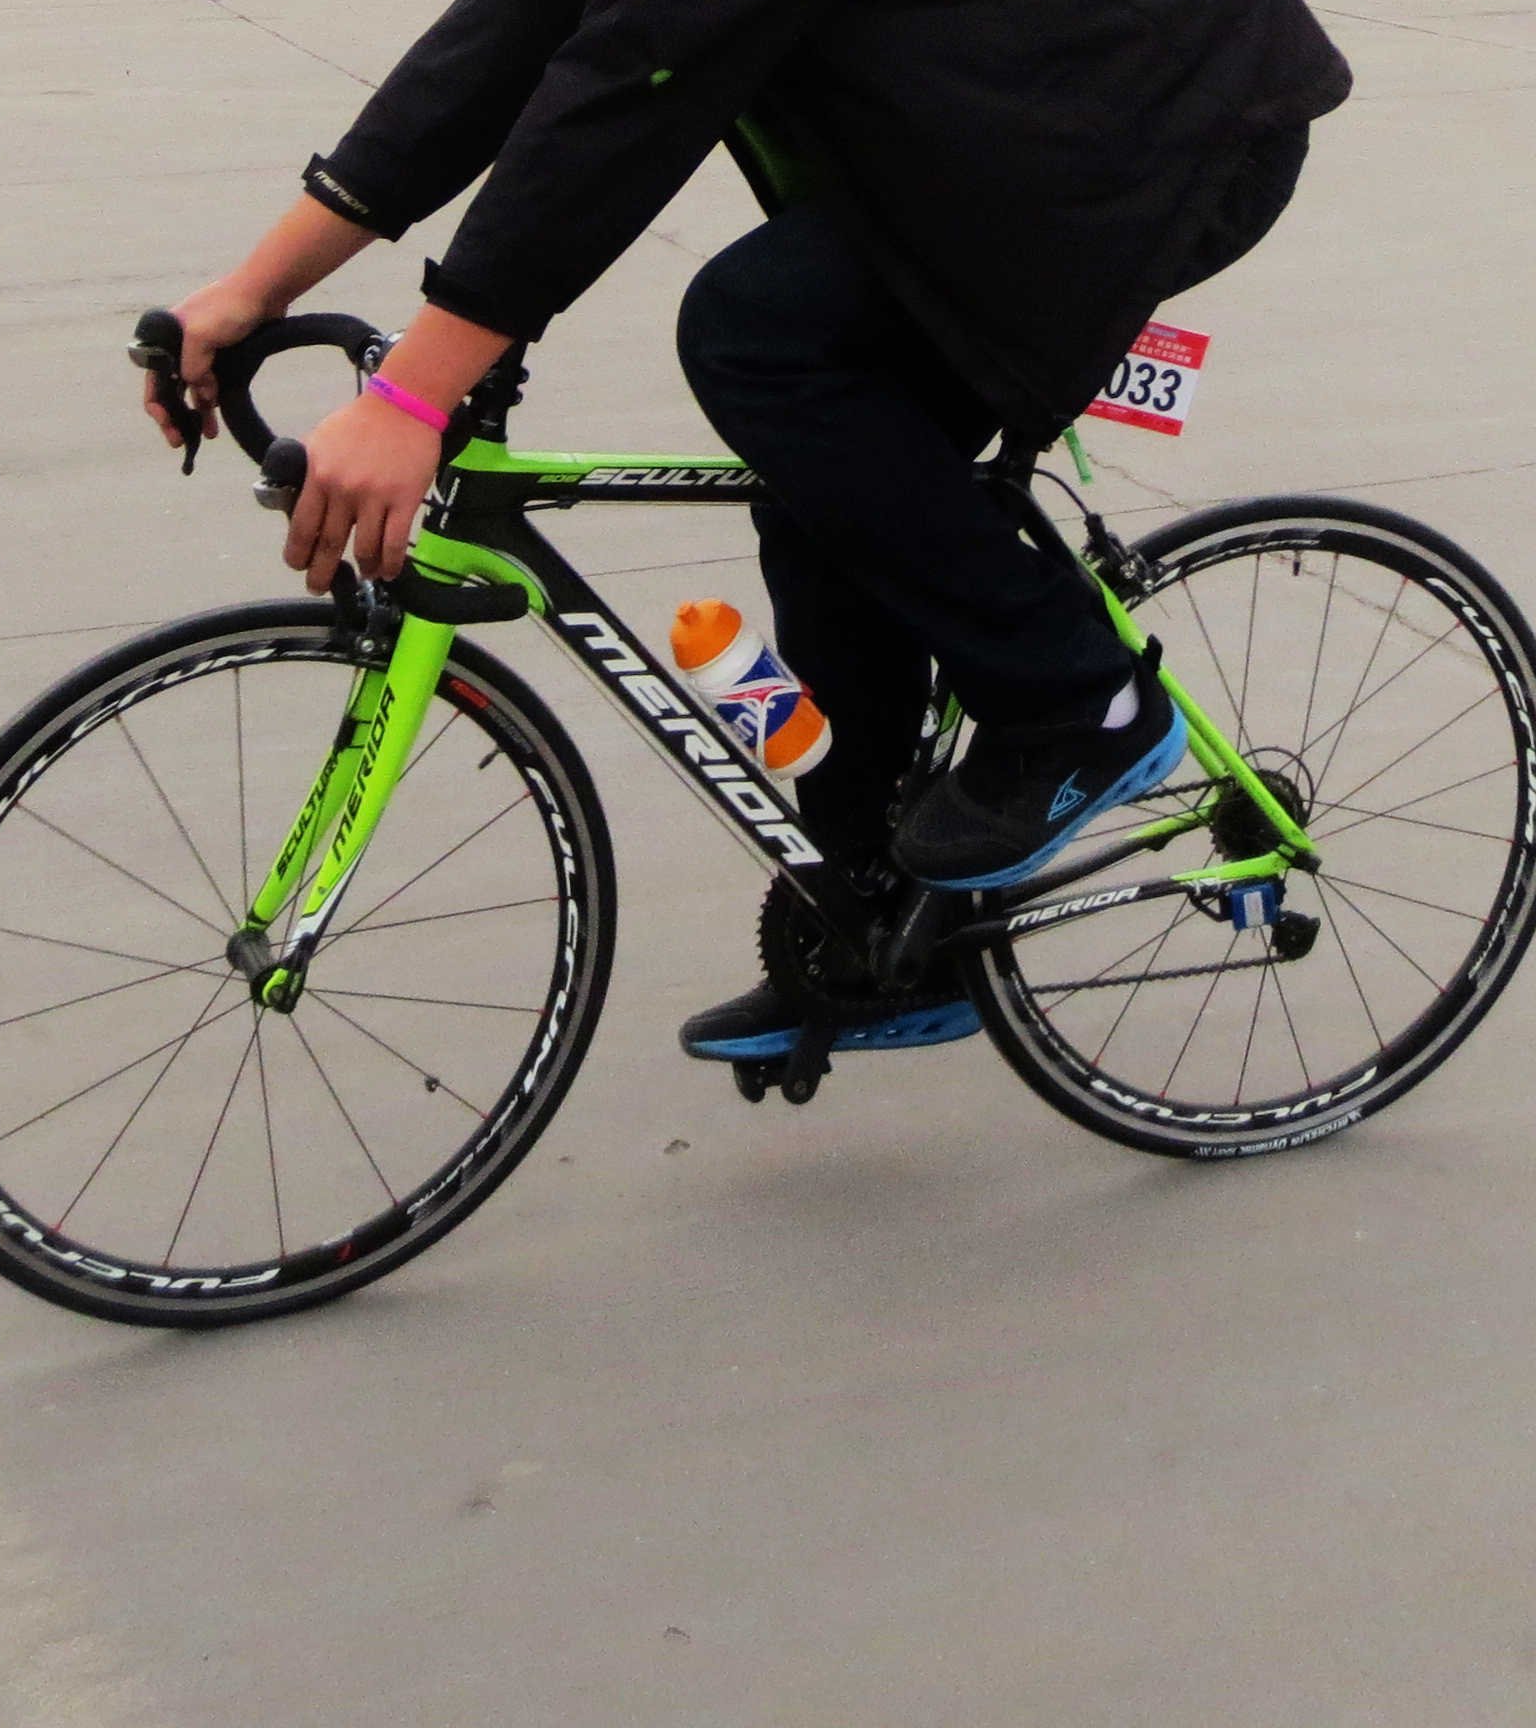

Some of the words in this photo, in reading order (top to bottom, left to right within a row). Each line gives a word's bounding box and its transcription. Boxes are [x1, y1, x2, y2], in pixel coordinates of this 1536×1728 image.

[1105, 357, 1182, 412] 033
[331, 682, 396, 863] MERIDA
[558, 612, 825, 865] MERIDA
[1007, 885, 1141, 932] MERIDA
